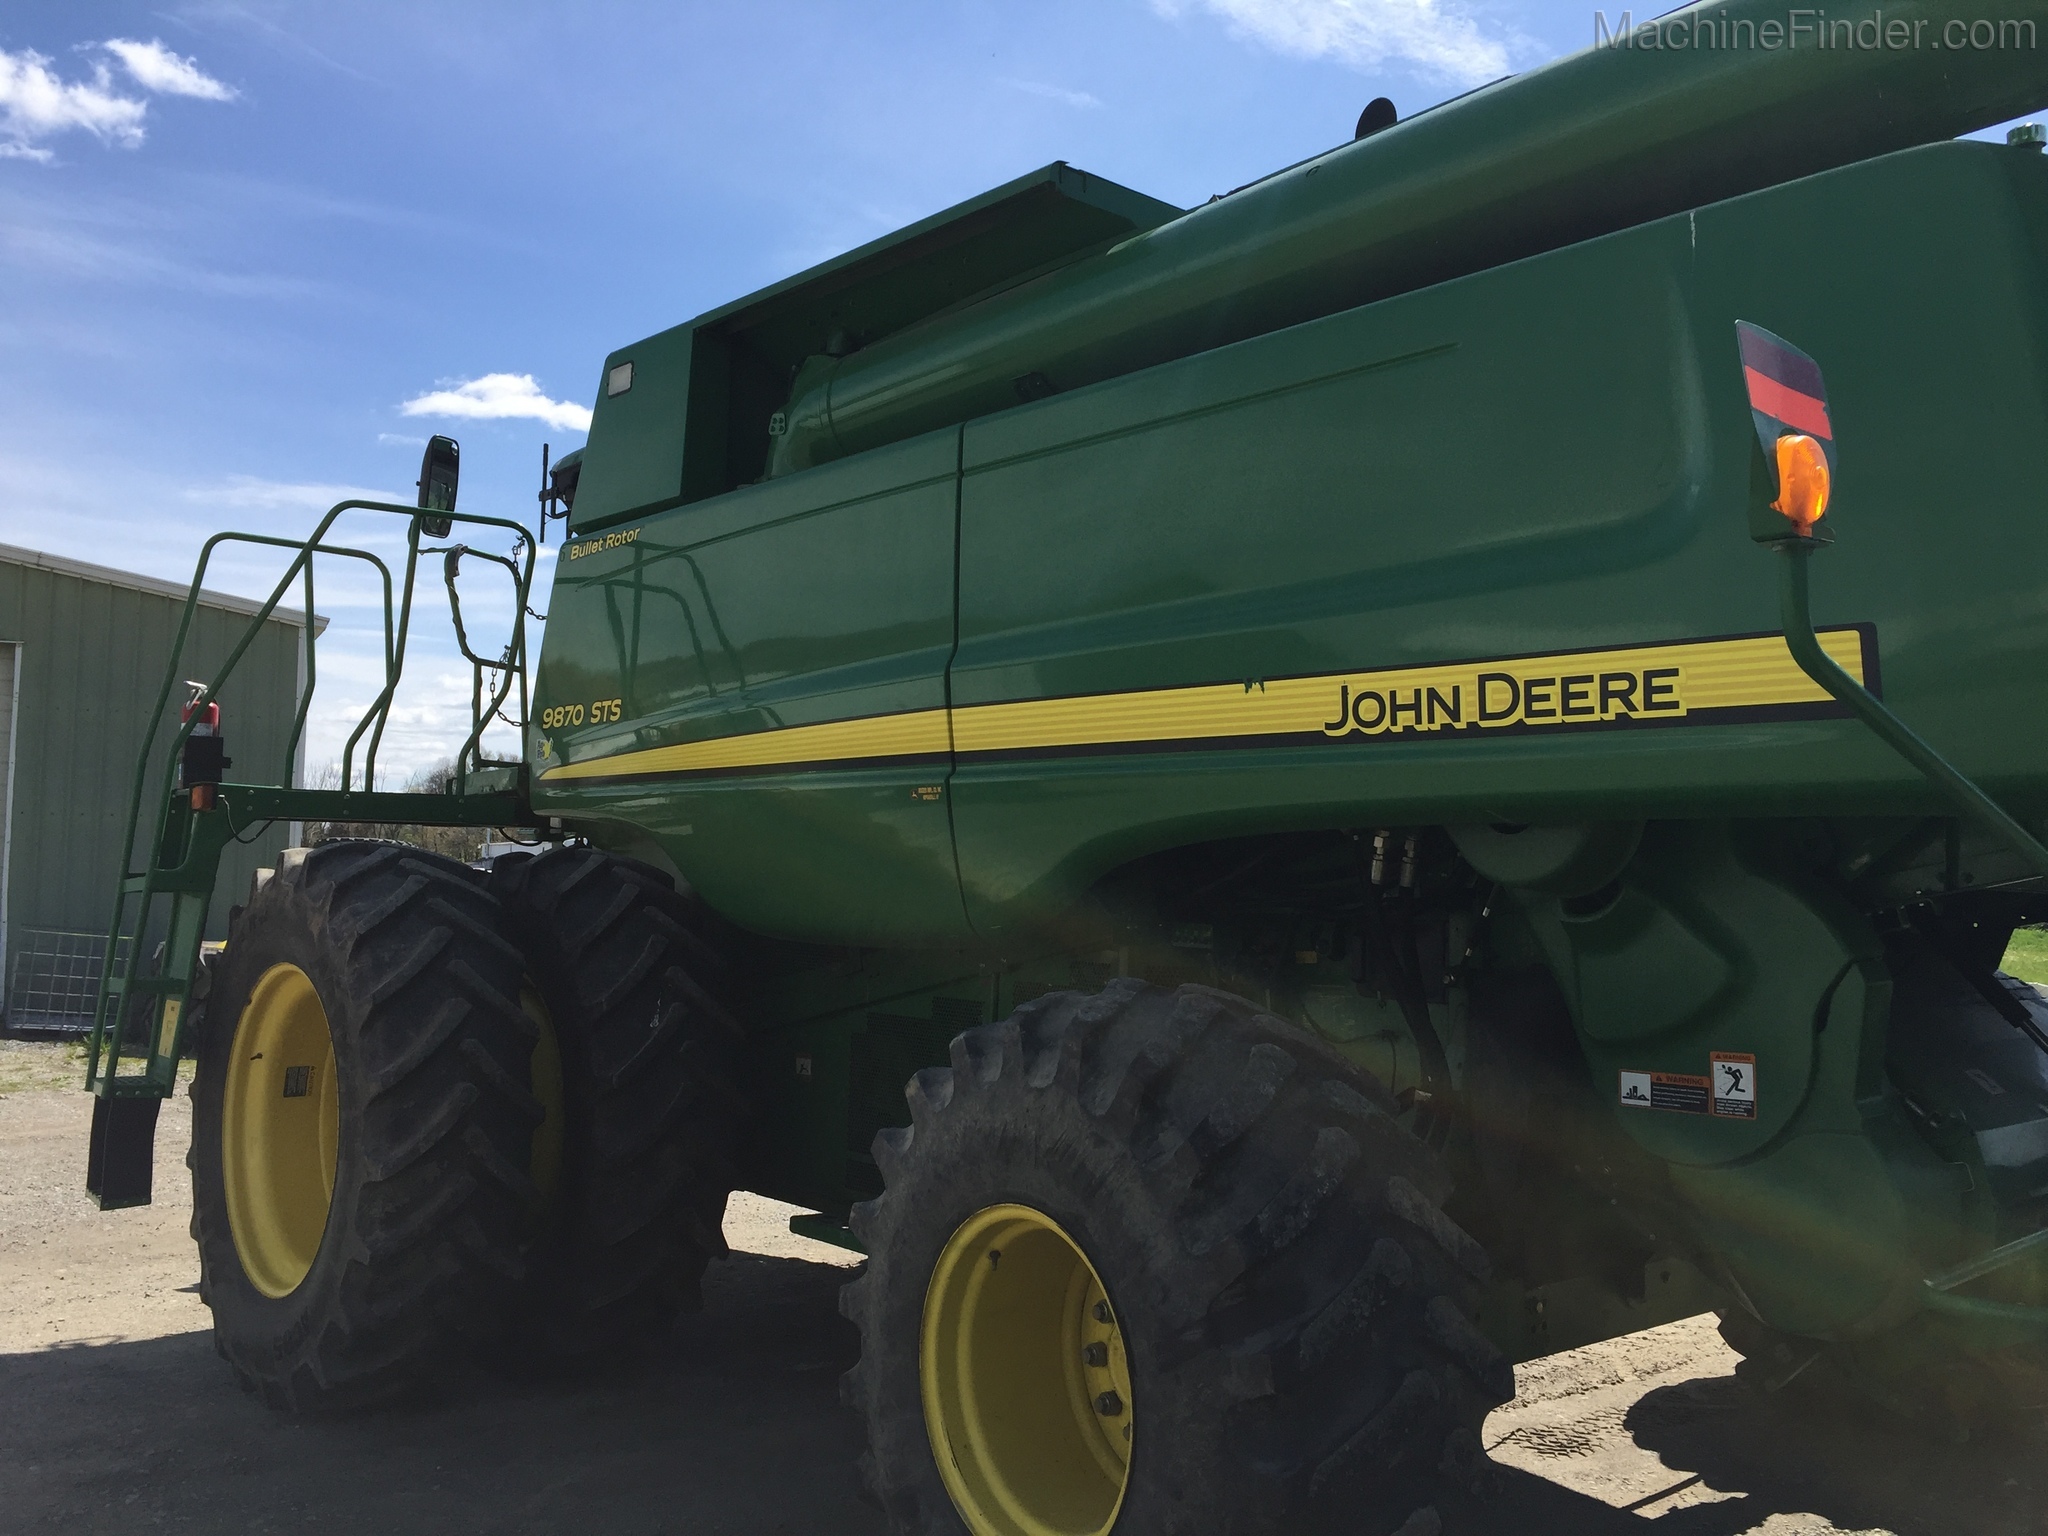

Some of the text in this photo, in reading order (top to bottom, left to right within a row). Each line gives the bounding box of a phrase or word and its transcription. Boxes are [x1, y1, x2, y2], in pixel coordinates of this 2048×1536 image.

[570, 528, 641, 560] Bullet Rotor
[542, 699, 622, 729] 9870 STS
[1324, 667, 1684, 733] JOHN DEERE
[1666, 1075, 1704, 1086] WARNING
